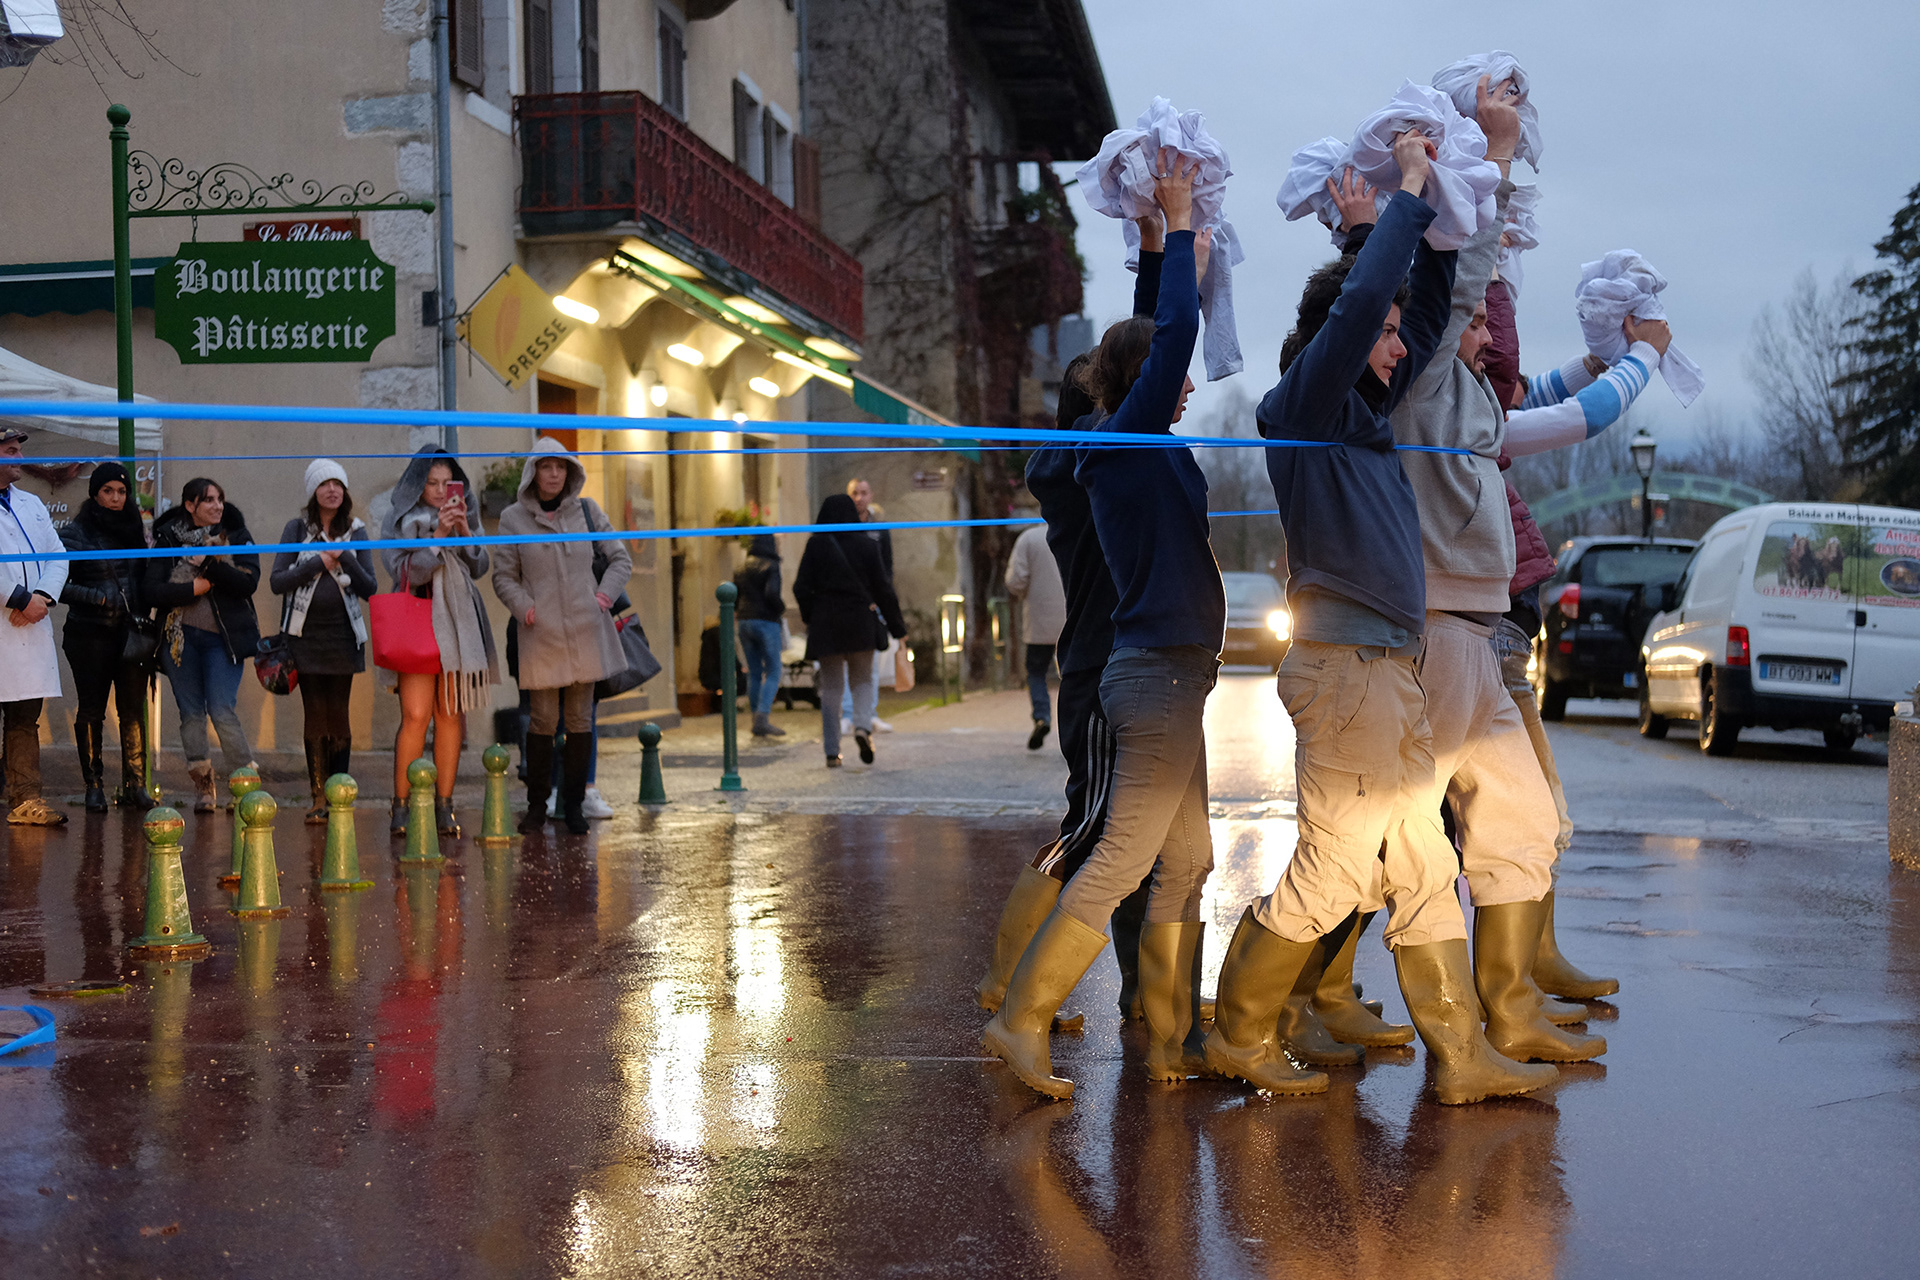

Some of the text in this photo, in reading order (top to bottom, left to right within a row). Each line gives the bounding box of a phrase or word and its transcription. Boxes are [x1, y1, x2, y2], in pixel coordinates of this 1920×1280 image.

[257, 222, 353, 242] Le Rhône
[174, 258, 384, 299] Boulangerie
[191, 314, 368, 357] Pâtisserie
[508, 318, 567, 380] PRESSE
[1788, 508, 1821, 519] Balade
[1825, 511, 1834, 519] et
[1879, 515, 1890, 523] en
[1885, 528, 1920, 543] Attela
